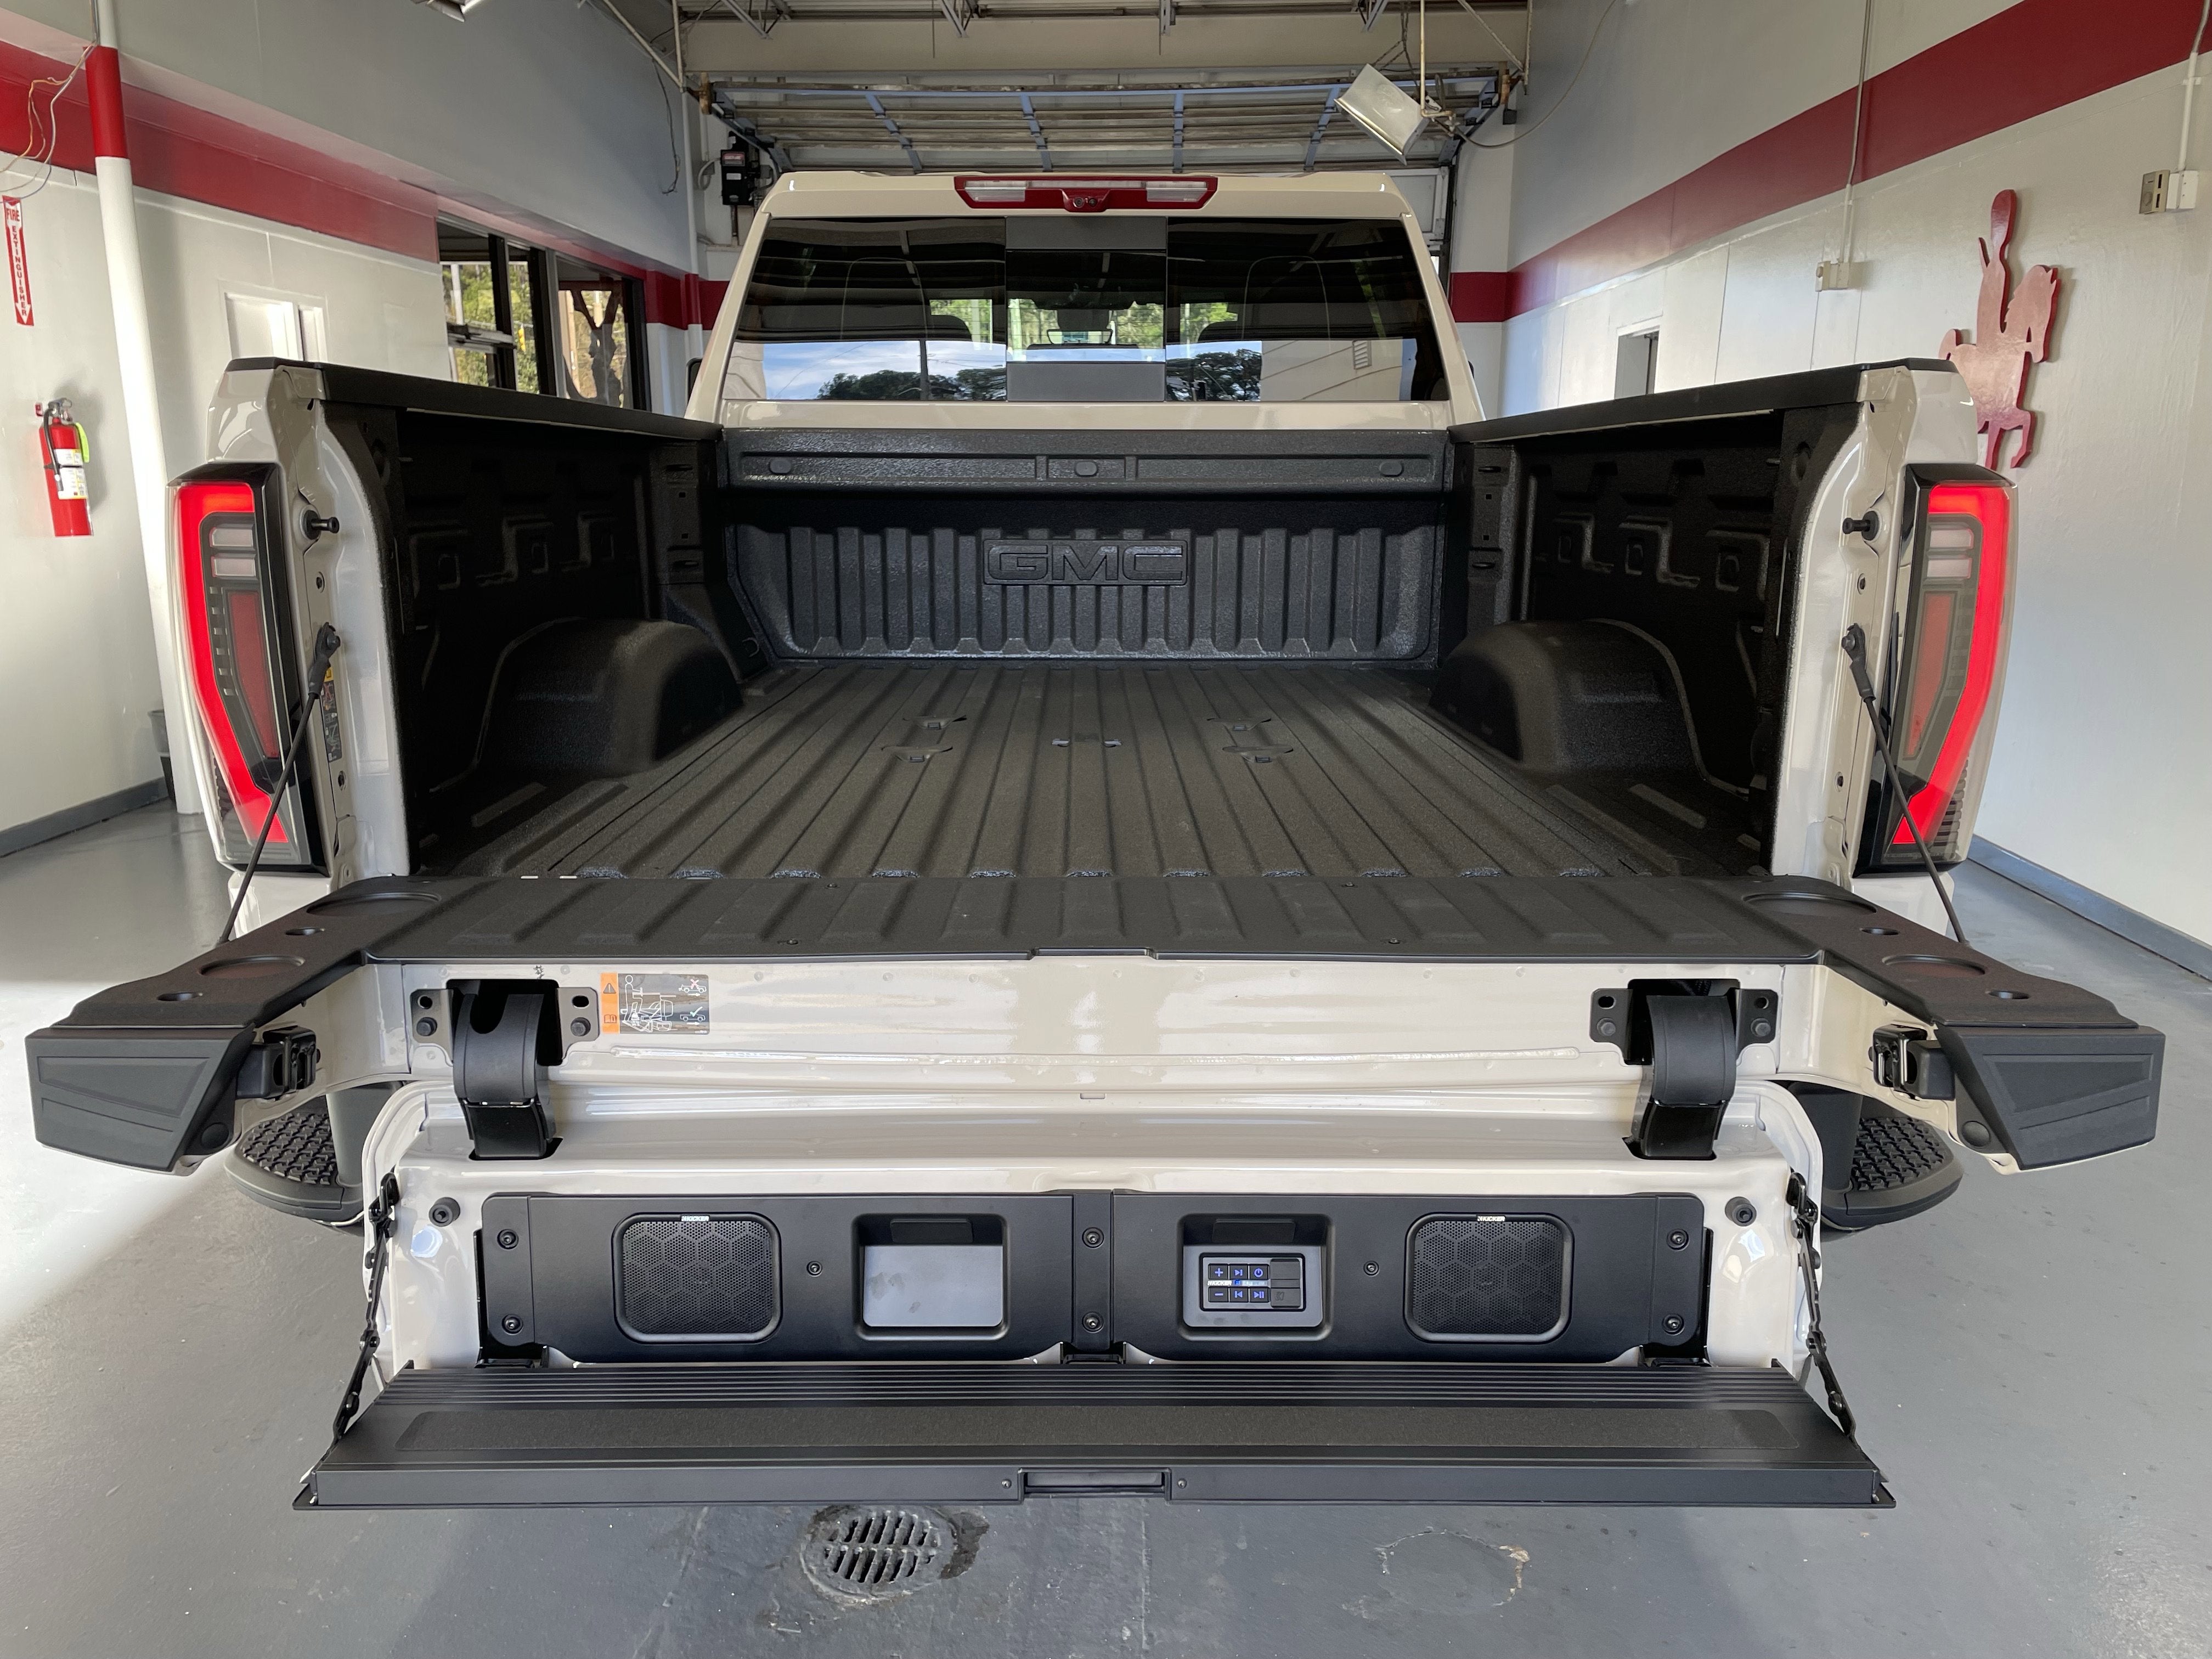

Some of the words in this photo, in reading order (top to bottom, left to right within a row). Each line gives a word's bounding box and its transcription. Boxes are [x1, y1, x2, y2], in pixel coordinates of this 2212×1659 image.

[6, 208, 20, 221] FIRE
[12, 225, 27, 316] EXTINGUISHER
[989, 545, 1183, 580] GMC
